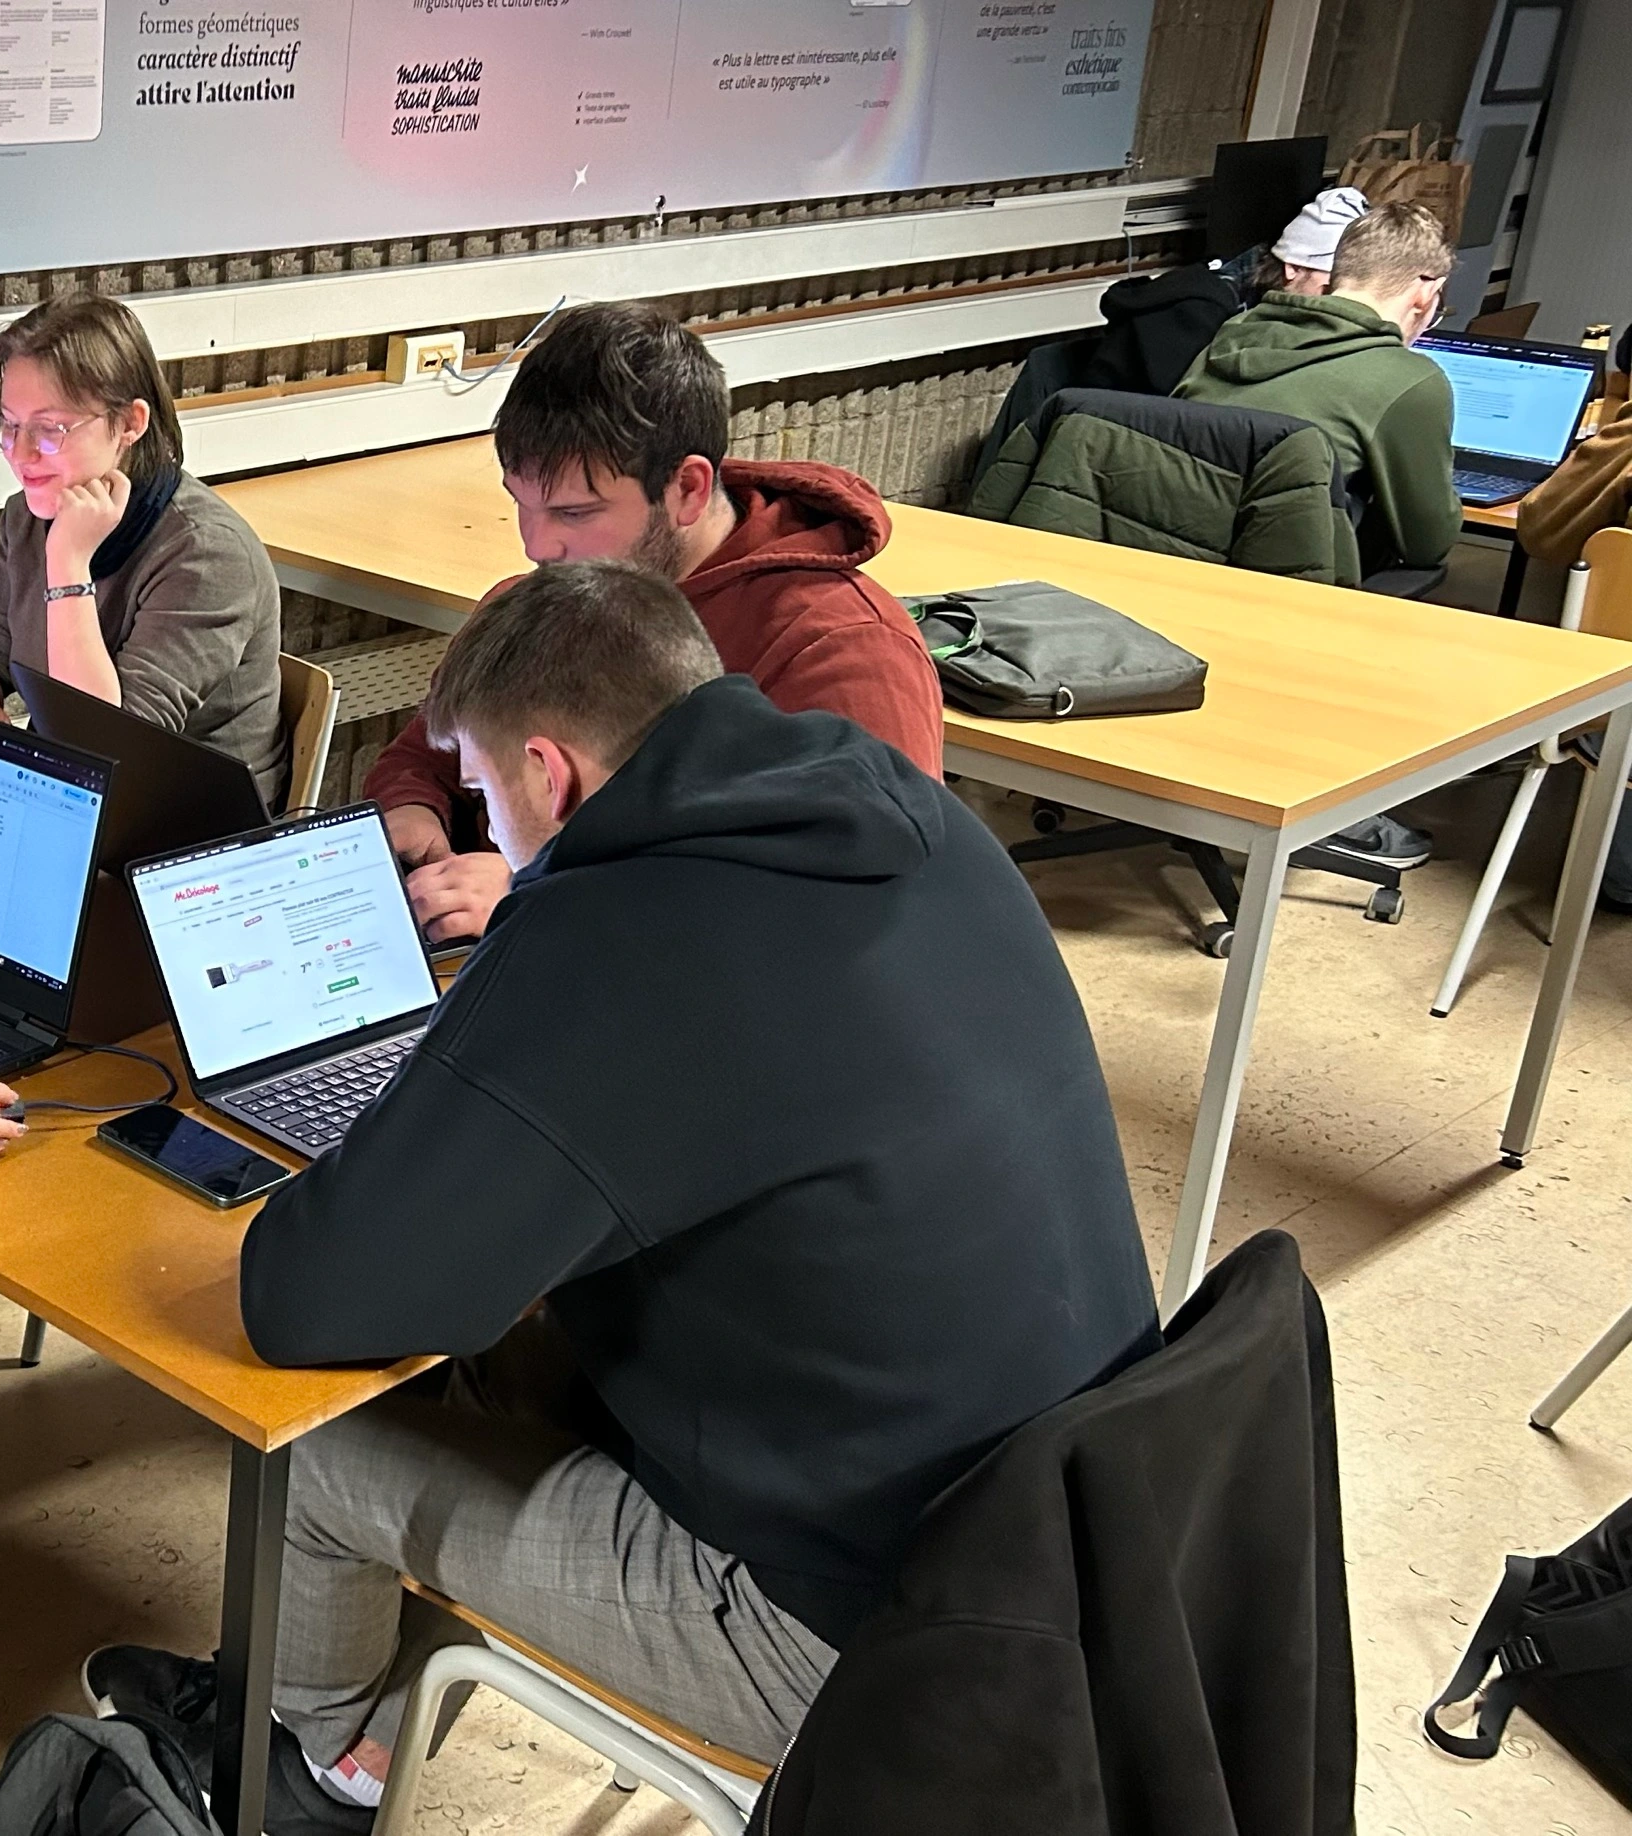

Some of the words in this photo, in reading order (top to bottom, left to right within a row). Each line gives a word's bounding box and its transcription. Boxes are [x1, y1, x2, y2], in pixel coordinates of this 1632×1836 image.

[139, 11, 193, 34] formes
[198, 12, 299, 39] géométriques
[1070, 23, 1101, 50] traits
[1103, 20, 1127, 48] fins
[137, 45, 217, 70] caractère
[221, 41, 301, 73] distinctif
[397, 57, 483, 84] manuscrite
[721, 53, 741, 68] Plus
[744, 53, 752, 67] la
[754, 52, 779, 67] lettre
[781, 52, 794, 65] est
[861, 48, 880, 65] plus
[881, 47, 897, 62] elle
[1065, 51, 1123, 78] esthétique
[136, 81, 191, 106] attire
[196, 77, 295, 104] l'attention
[719, 77, 733, 90] est
[735, 74, 755, 89] utile
[757, 76, 769, 88] au
[770, 72, 821, 92] typographe
[394, 87, 432, 110] traits
[431, 84, 481, 114] fluides
[391, 113, 480, 136] SOPHISTICATION
